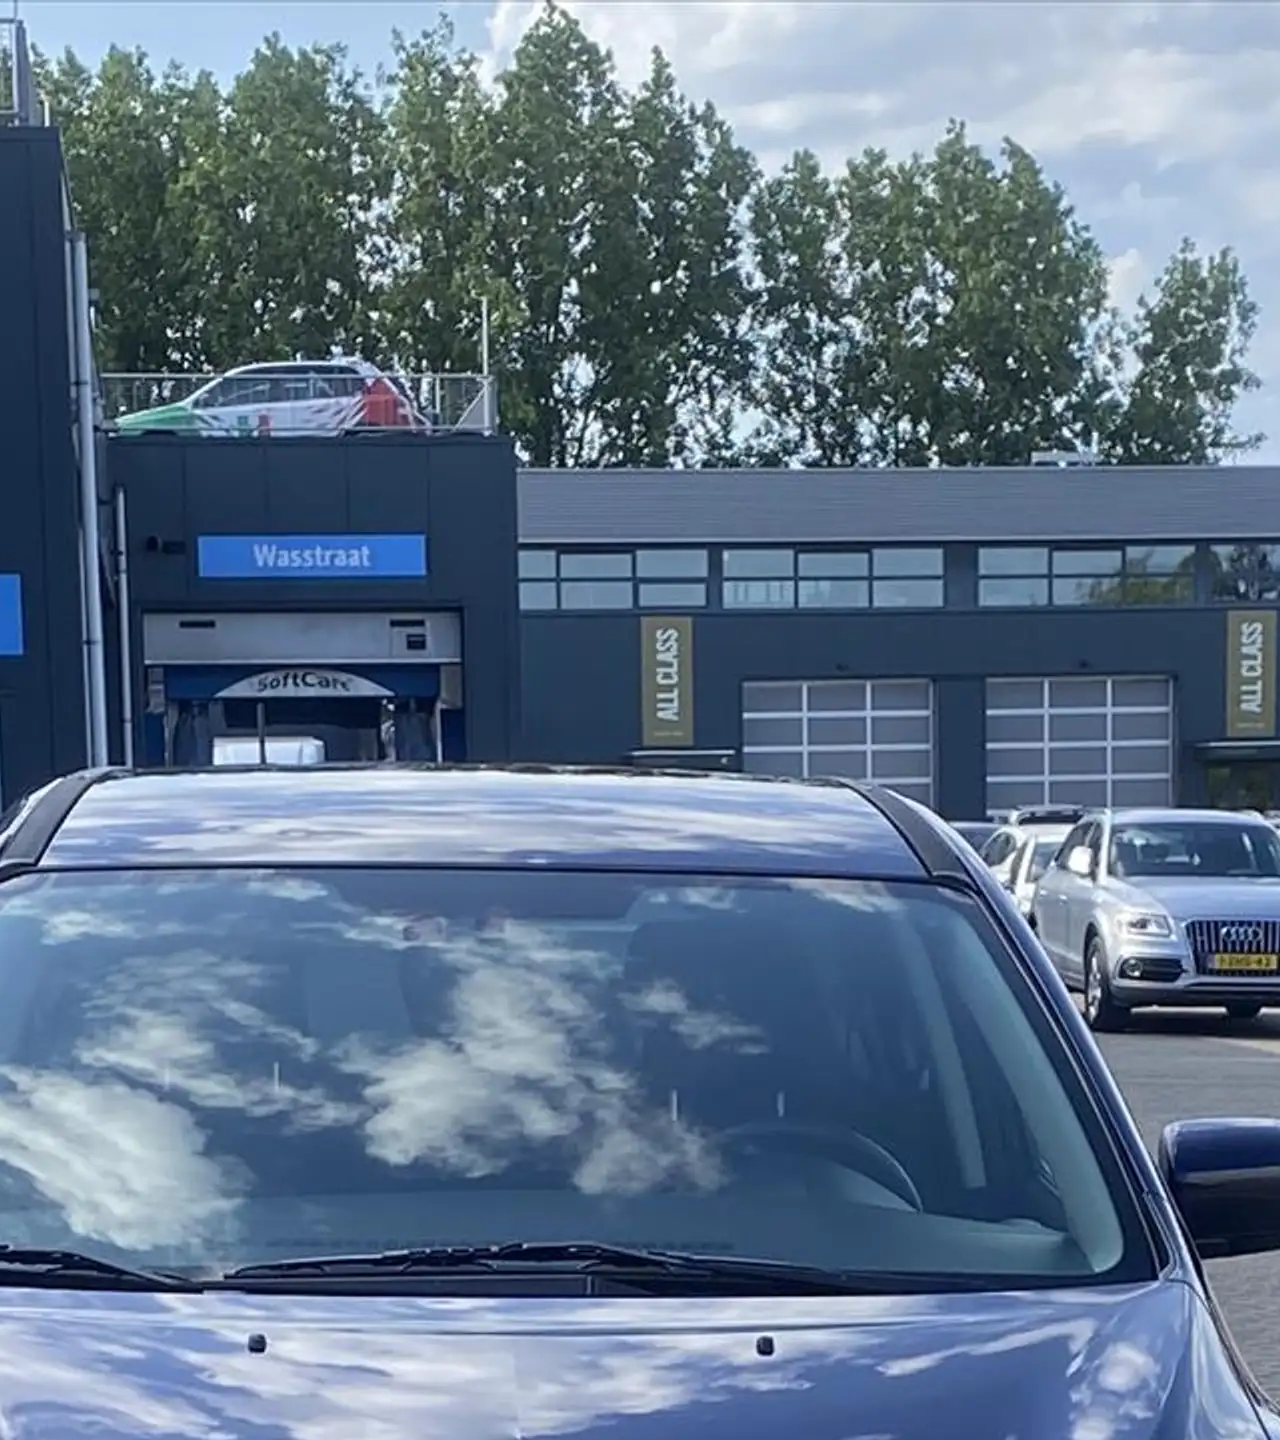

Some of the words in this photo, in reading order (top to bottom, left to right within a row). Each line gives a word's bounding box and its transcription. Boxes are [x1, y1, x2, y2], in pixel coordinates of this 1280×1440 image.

[252, 543, 371, 568] Wasstraat
[655, 627, 680, 685] CLASS
[1240, 621, 1263, 677] CLASS
[655, 687, 680, 721] ALL
[1240, 680, 1263, 713] ALL
